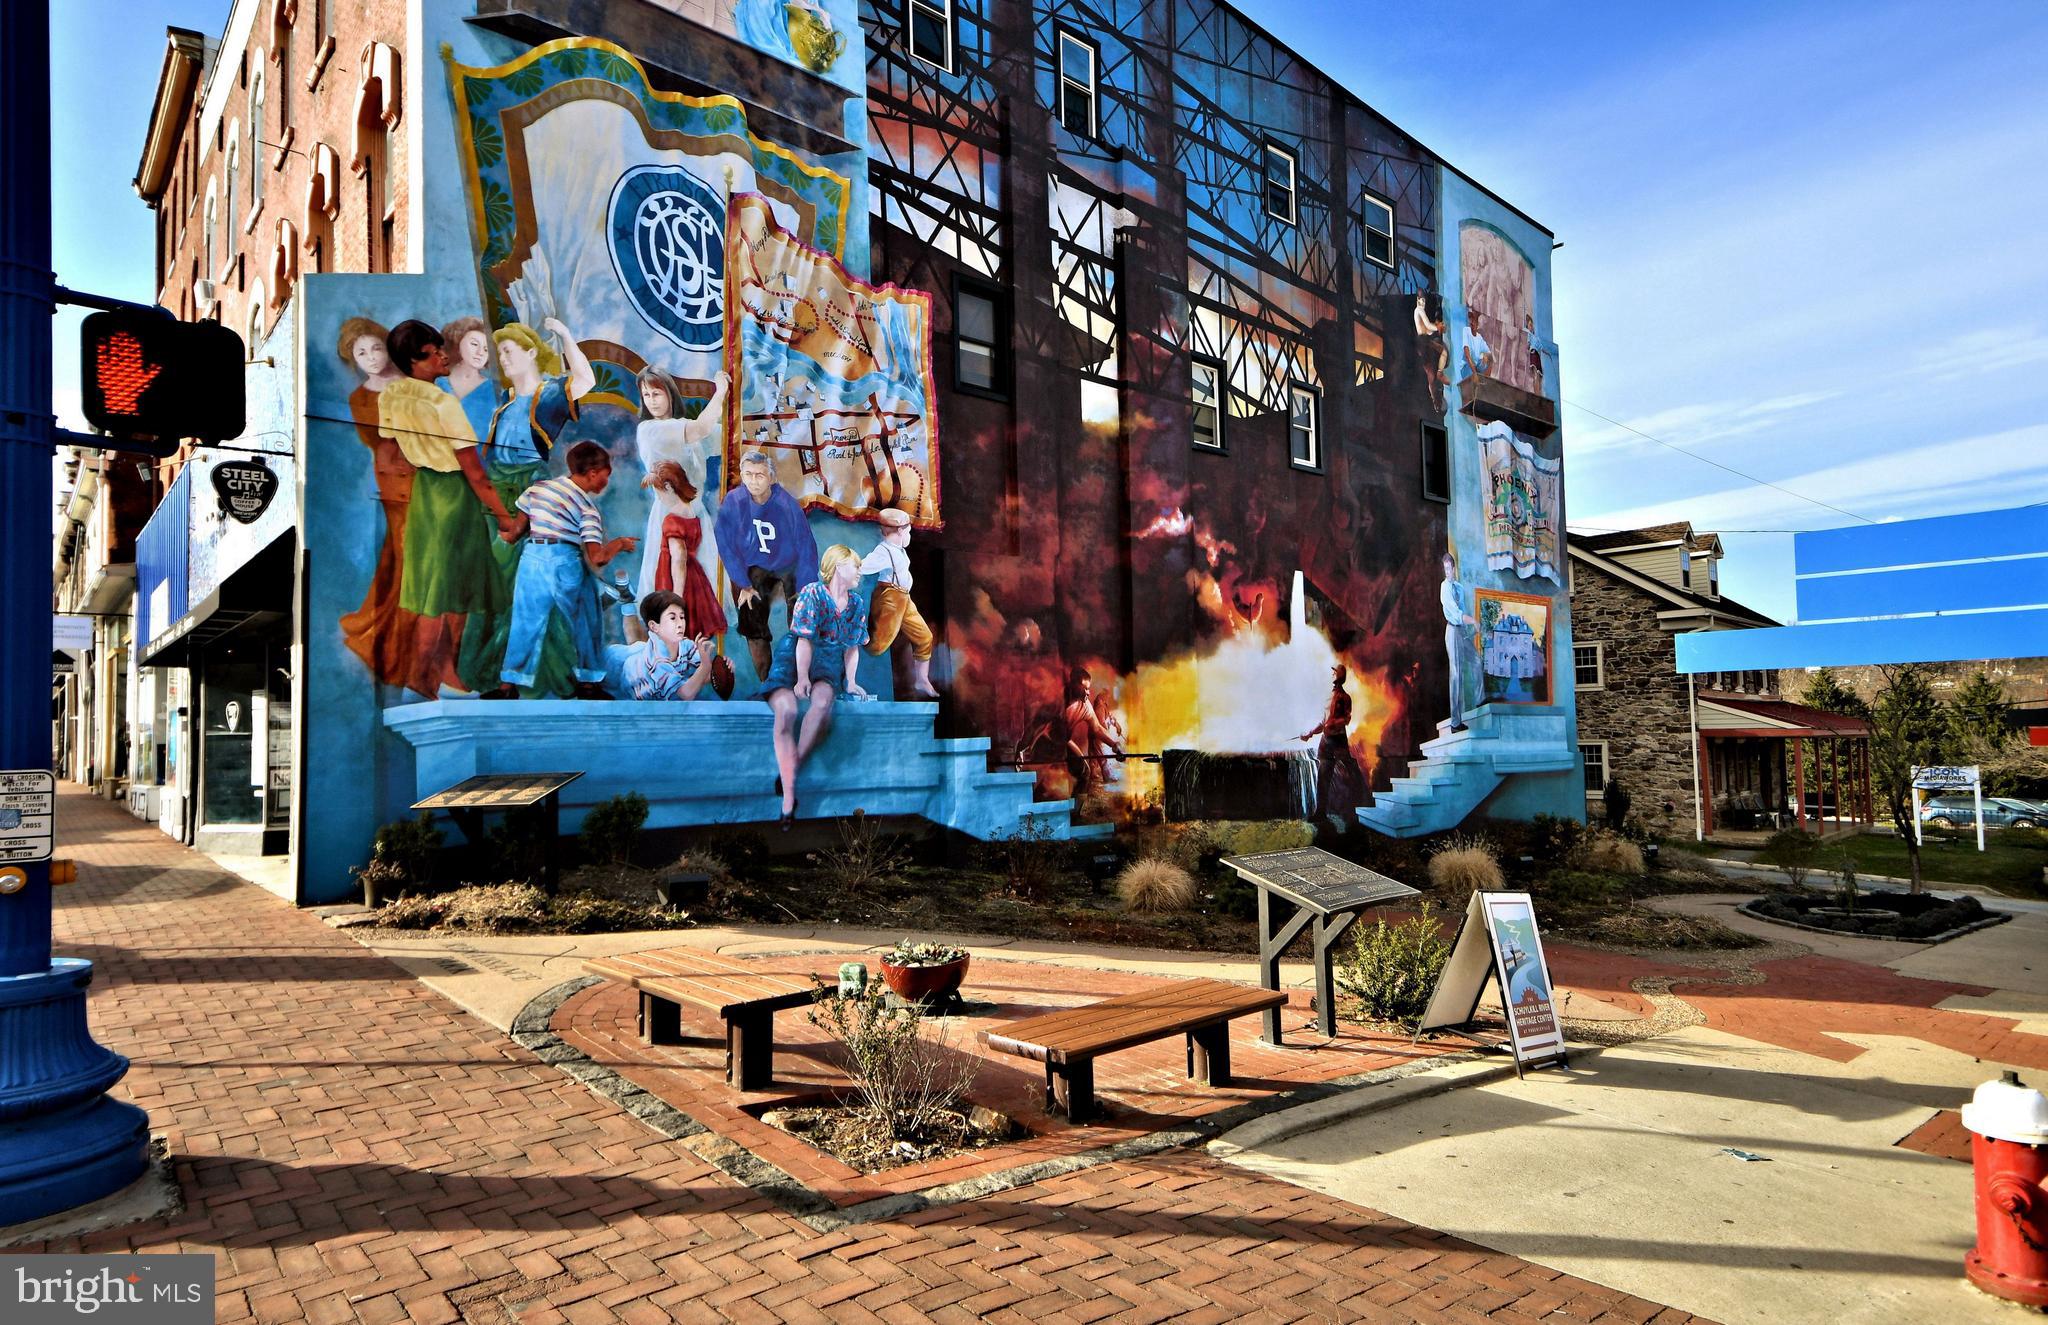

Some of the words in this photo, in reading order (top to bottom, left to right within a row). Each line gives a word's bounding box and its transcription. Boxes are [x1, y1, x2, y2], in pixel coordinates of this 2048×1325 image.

[221, 467, 269, 482] STEEL
[226, 479, 263, 491] CITY
[752, 518, 776, 554] P
[1930, 768, 1960, 776] ICON
[1513, 1005, 1538, 1015] SCHUYLKILL
[1539, 1003, 1550, 1012] RIVER
[1517, 1015, 1537, 1025] HERITAGE
[1536, 1013, 1552, 1024] CENTER
